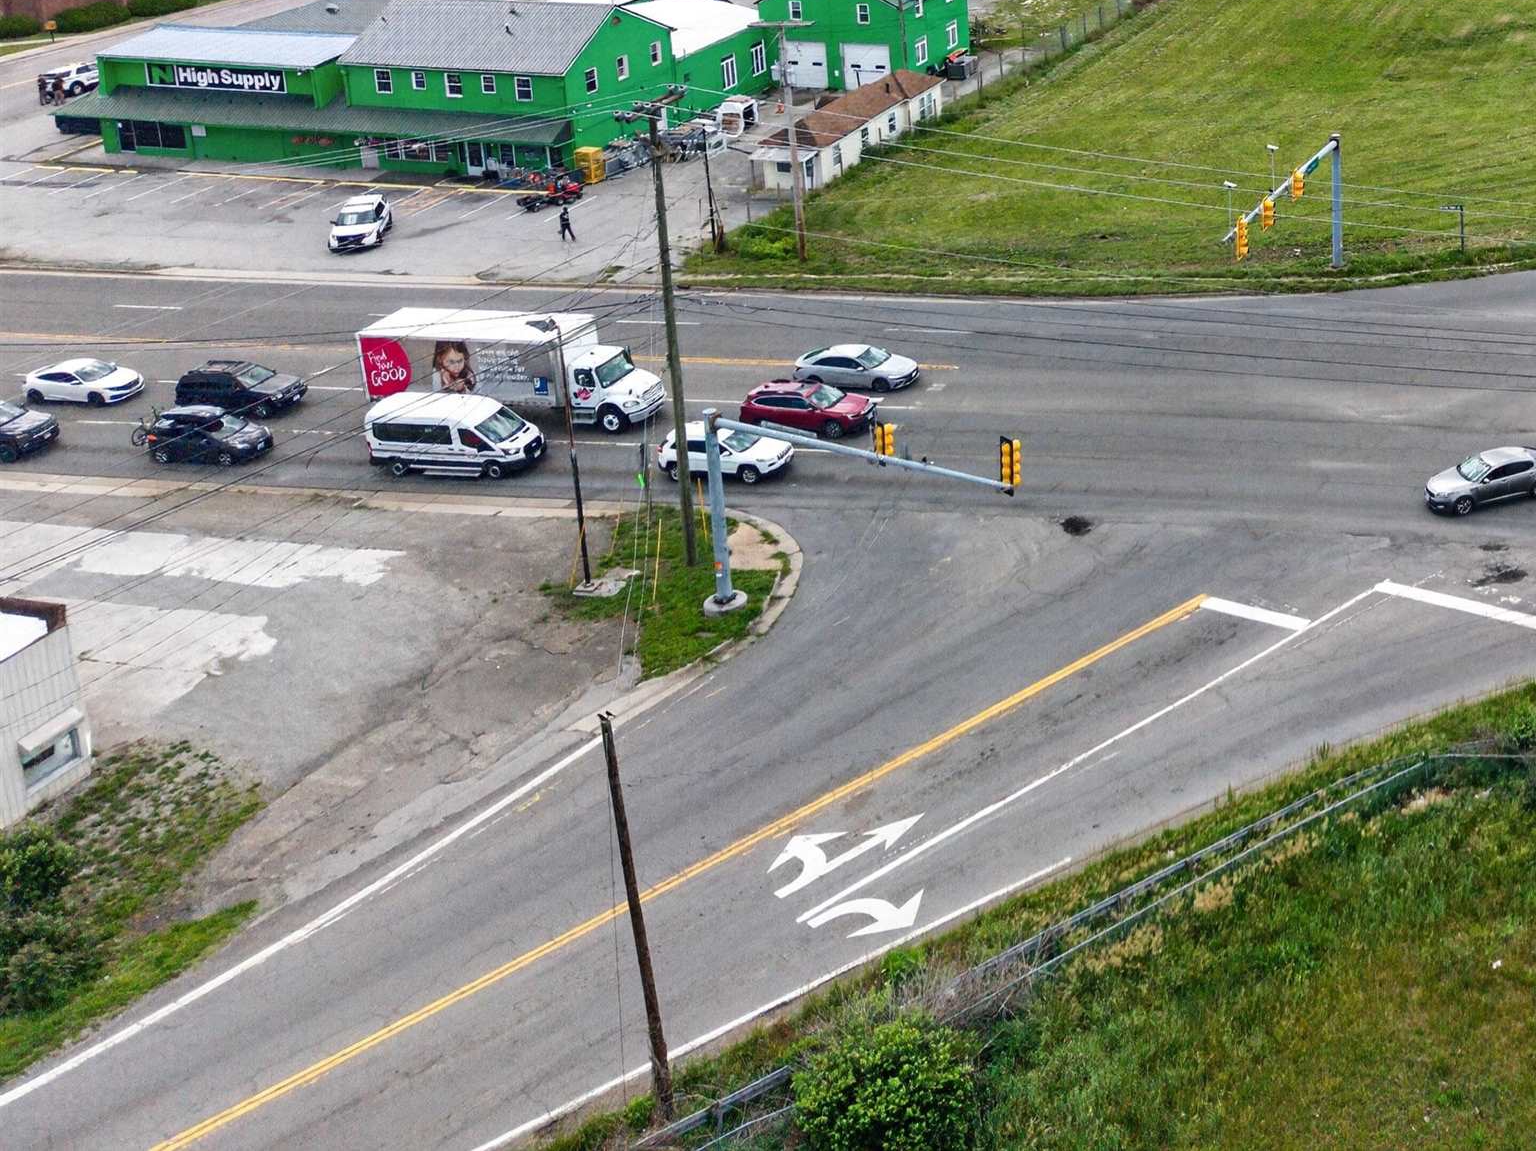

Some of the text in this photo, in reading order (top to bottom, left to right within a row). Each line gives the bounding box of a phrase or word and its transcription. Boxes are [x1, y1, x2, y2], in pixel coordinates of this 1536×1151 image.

[178, 66, 219, 87] High
[220, 69, 281, 91] Supply
[367, 348, 388, 364] Find
[371, 366, 407, 386] GOOD
